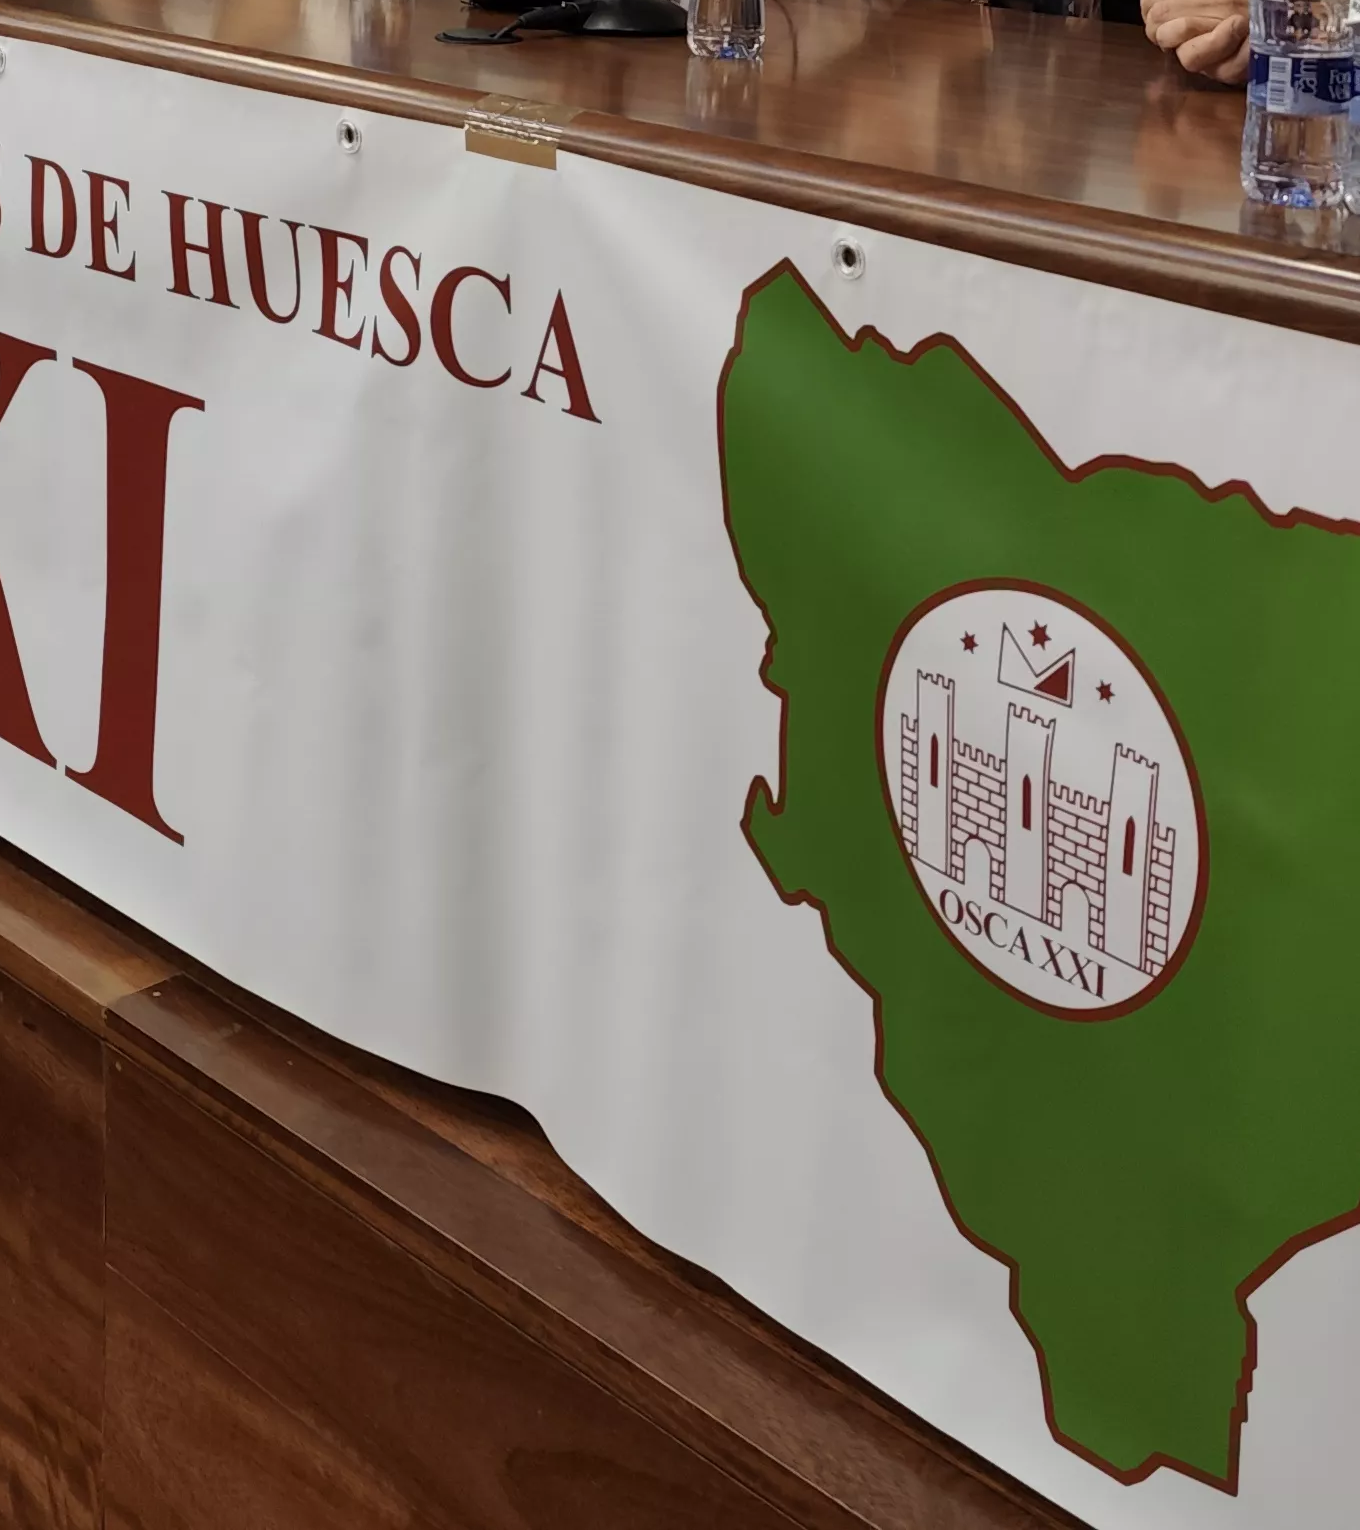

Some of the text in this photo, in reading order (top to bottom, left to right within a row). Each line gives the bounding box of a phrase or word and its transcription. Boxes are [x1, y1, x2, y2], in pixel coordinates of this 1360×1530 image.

[24, 154, 137, 282] DE
[160, 189, 603, 425] HUESCA
[939, 888, 1107, 1001] OSCA XXI
